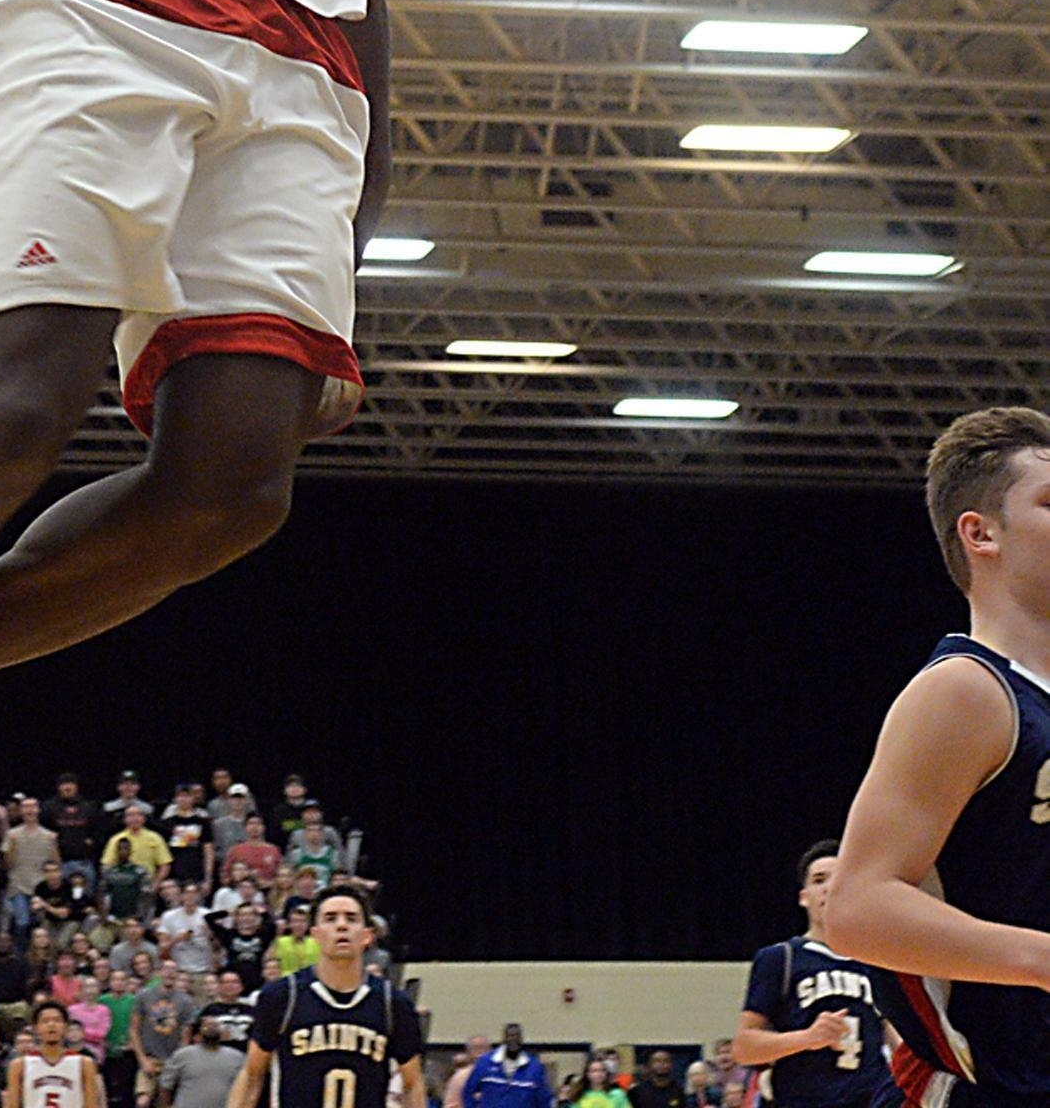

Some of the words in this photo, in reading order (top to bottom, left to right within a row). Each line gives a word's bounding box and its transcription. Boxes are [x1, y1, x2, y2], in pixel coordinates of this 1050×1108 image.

[796, 970, 878, 1010] SAINT
[290, 1022, 388, 1062] SAINTS
[322, 1068, 357, 1108] 0
